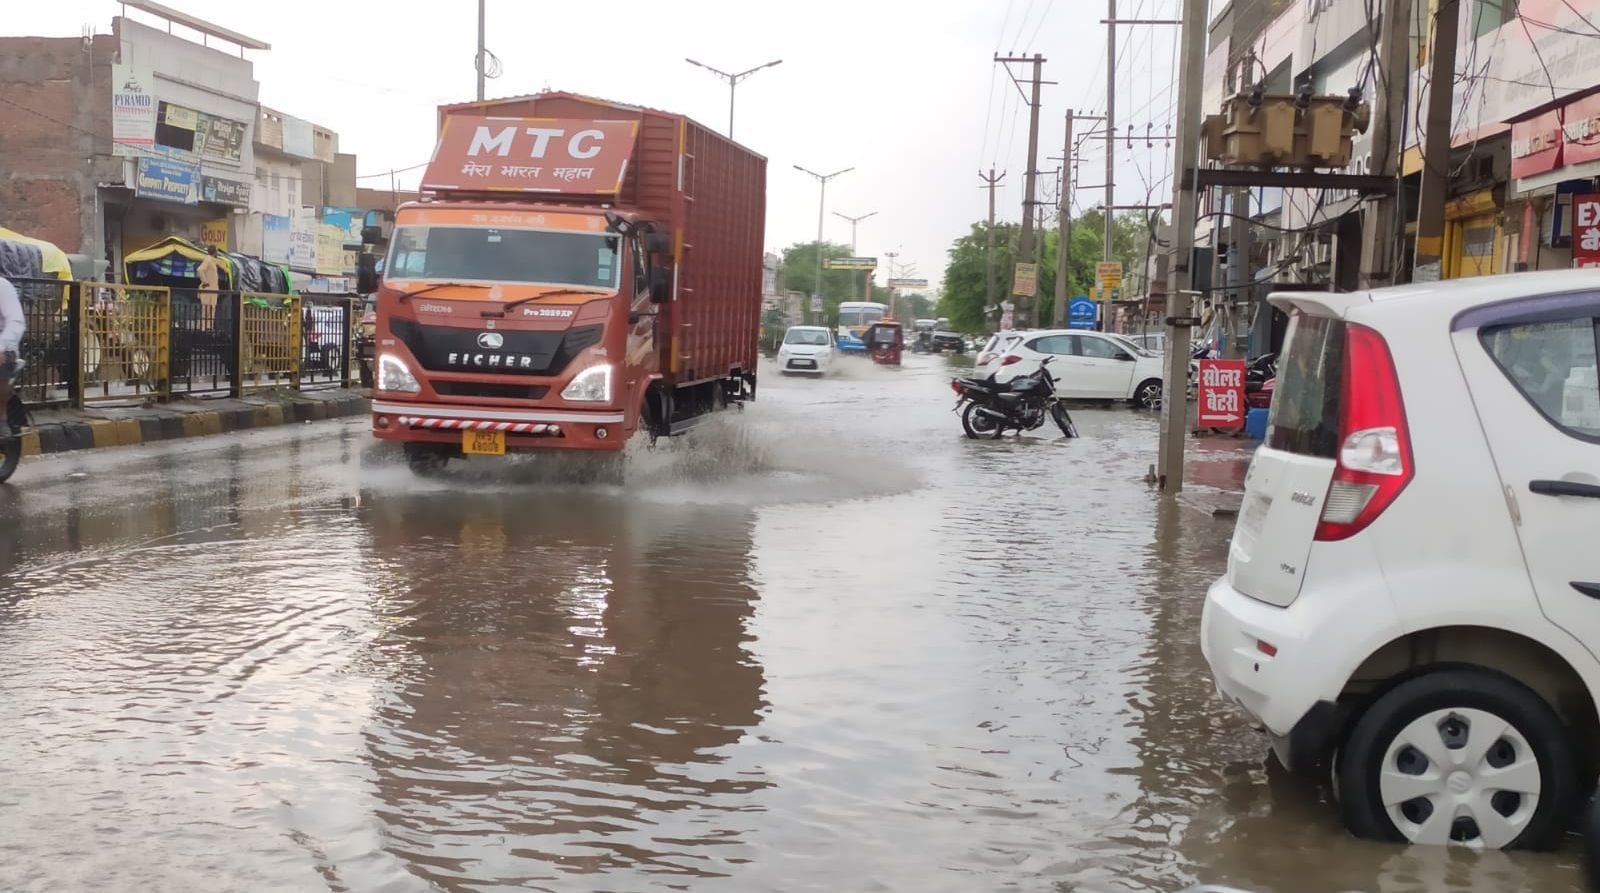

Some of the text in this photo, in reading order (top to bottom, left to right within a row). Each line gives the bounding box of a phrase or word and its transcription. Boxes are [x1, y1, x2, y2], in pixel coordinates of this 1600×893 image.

[114, 94, 151, 107] PYRAMID
[466, 126, 605, 159] MTC
[461, 161, 594, 182] मेरा भारत महान
[523, 308, 539, 317] Pro
[448, 353, 532, 368] EICHER
[1202, 364, 1242, 387] सोलर
[1205, 388, 1239, 412] बैटरी
